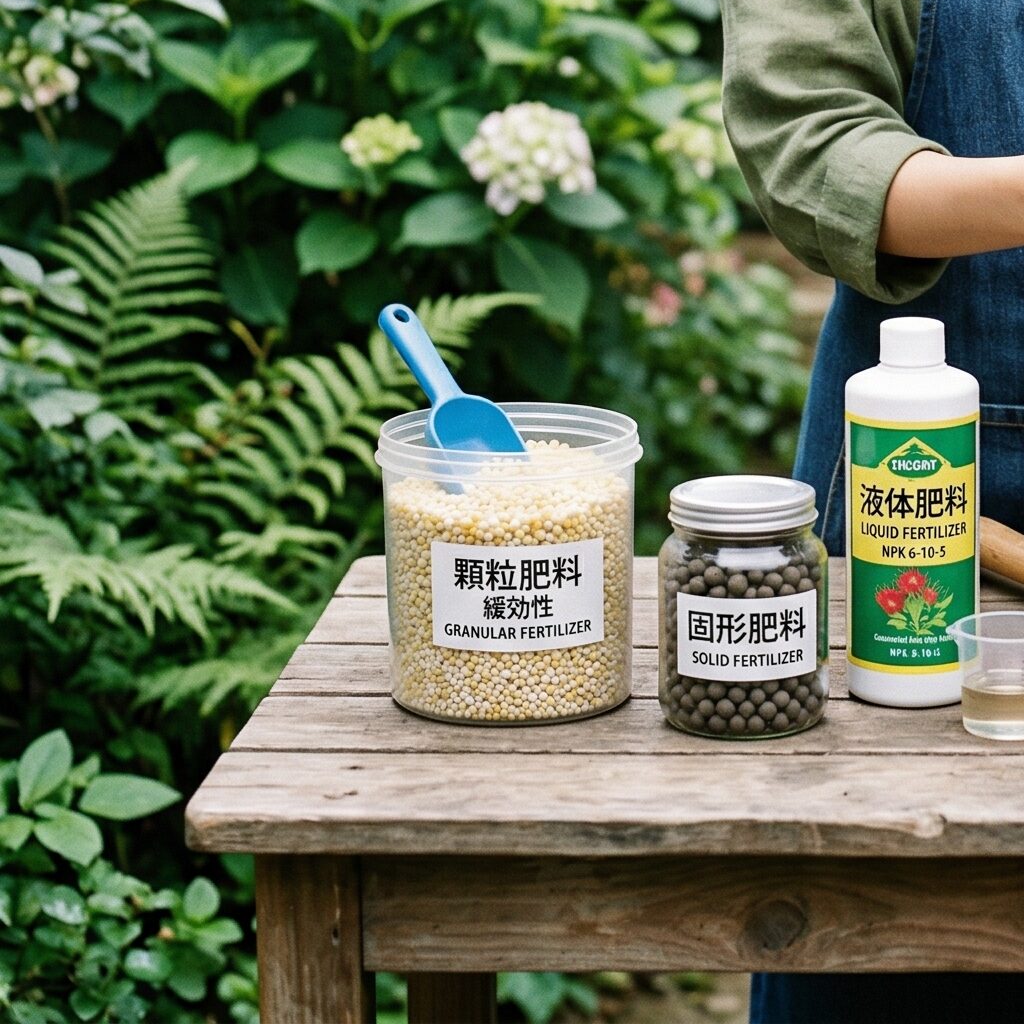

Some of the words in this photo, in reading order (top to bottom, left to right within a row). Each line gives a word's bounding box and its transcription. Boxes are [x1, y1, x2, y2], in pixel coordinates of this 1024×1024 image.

[860, 483, 967, 519] 液体肥料
[861, 521, 899, 539] LIQUID
[902, 521, 967, 540] FERTILIZER
[882, 545, 906, 559] NPK
[908, 546, 946, 559] 6-10-5
[454, 555, 582, 591] 顆粒肥料
[483, 594, 554, 620] 緩効性
[444, 623, 517, 640] GRANULAR
[520, 619, 592, 640] FERTILIZER
[688, 607, 806, 644] 固形肥料
[692, 651, 730, 667] SOLID
[733, 649, 804, 667] FERTILIZER
